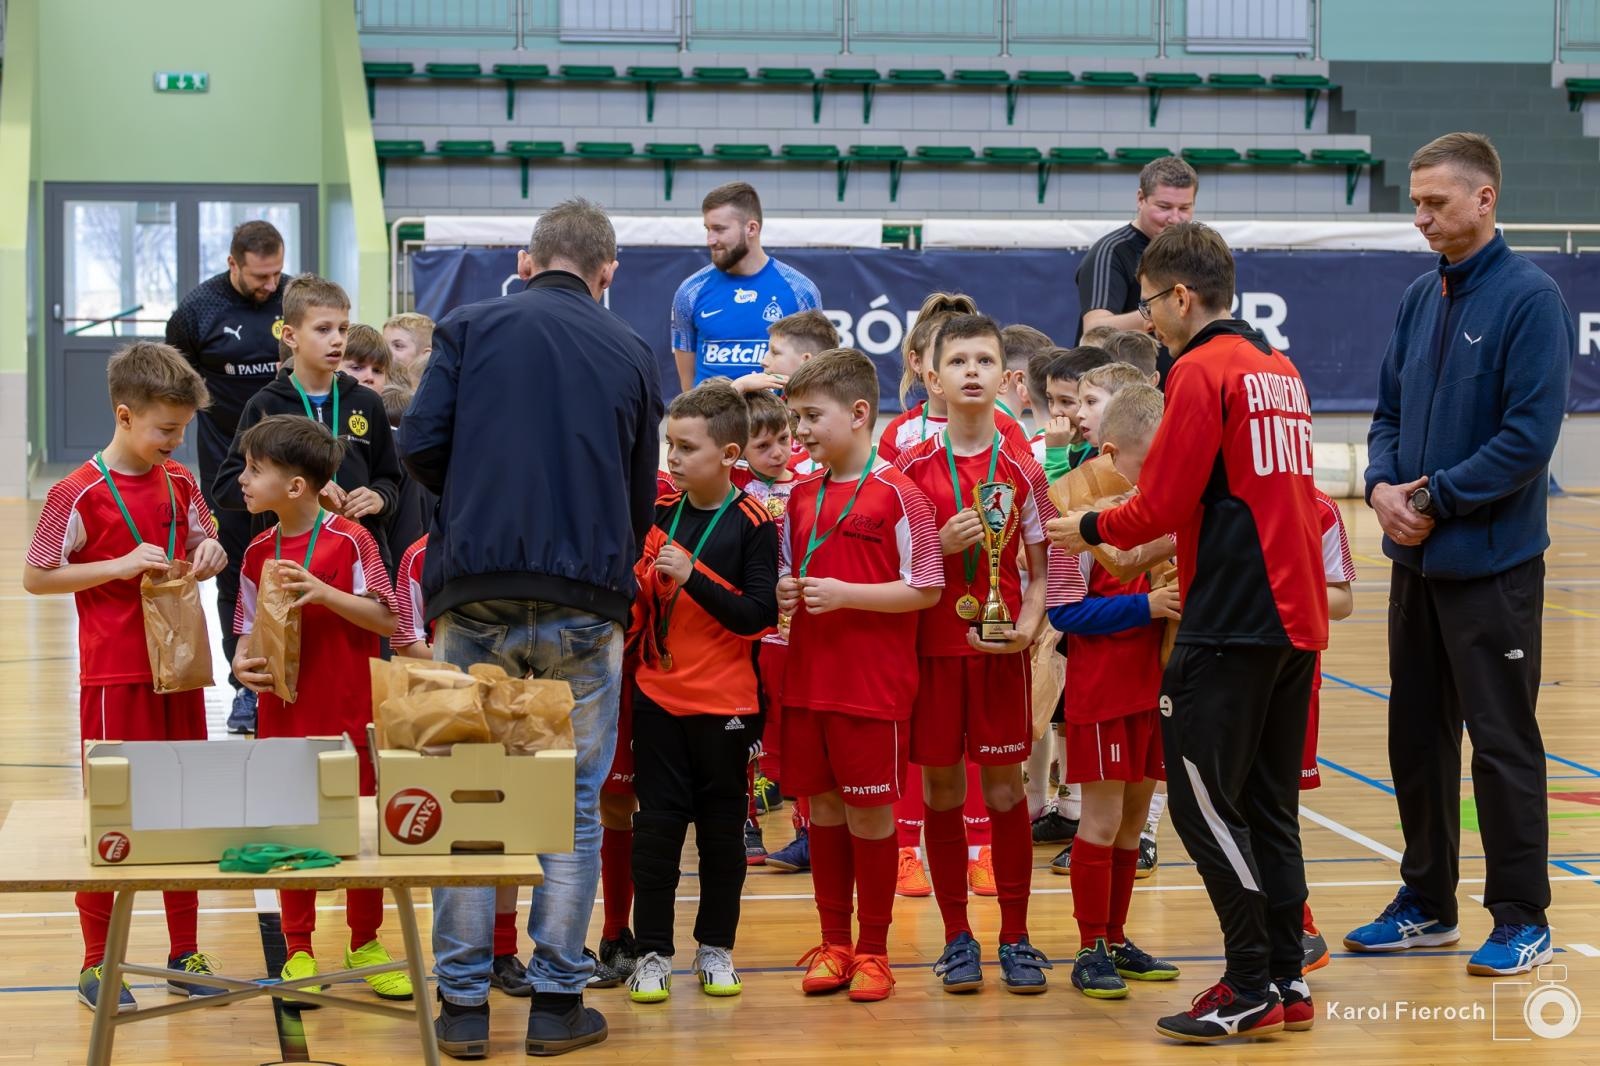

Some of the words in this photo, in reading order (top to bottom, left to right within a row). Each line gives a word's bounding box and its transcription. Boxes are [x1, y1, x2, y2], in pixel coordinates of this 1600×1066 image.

[989, 742, 1026, 754] PATRICK
[1110, 743, 1120, 762] 11
[852, 783, 891, 795] PATRICK
[394, 796, 427, 838] 7
[410, 799, 437, 837] DAYS
[103, 835, 122, 860] 7
